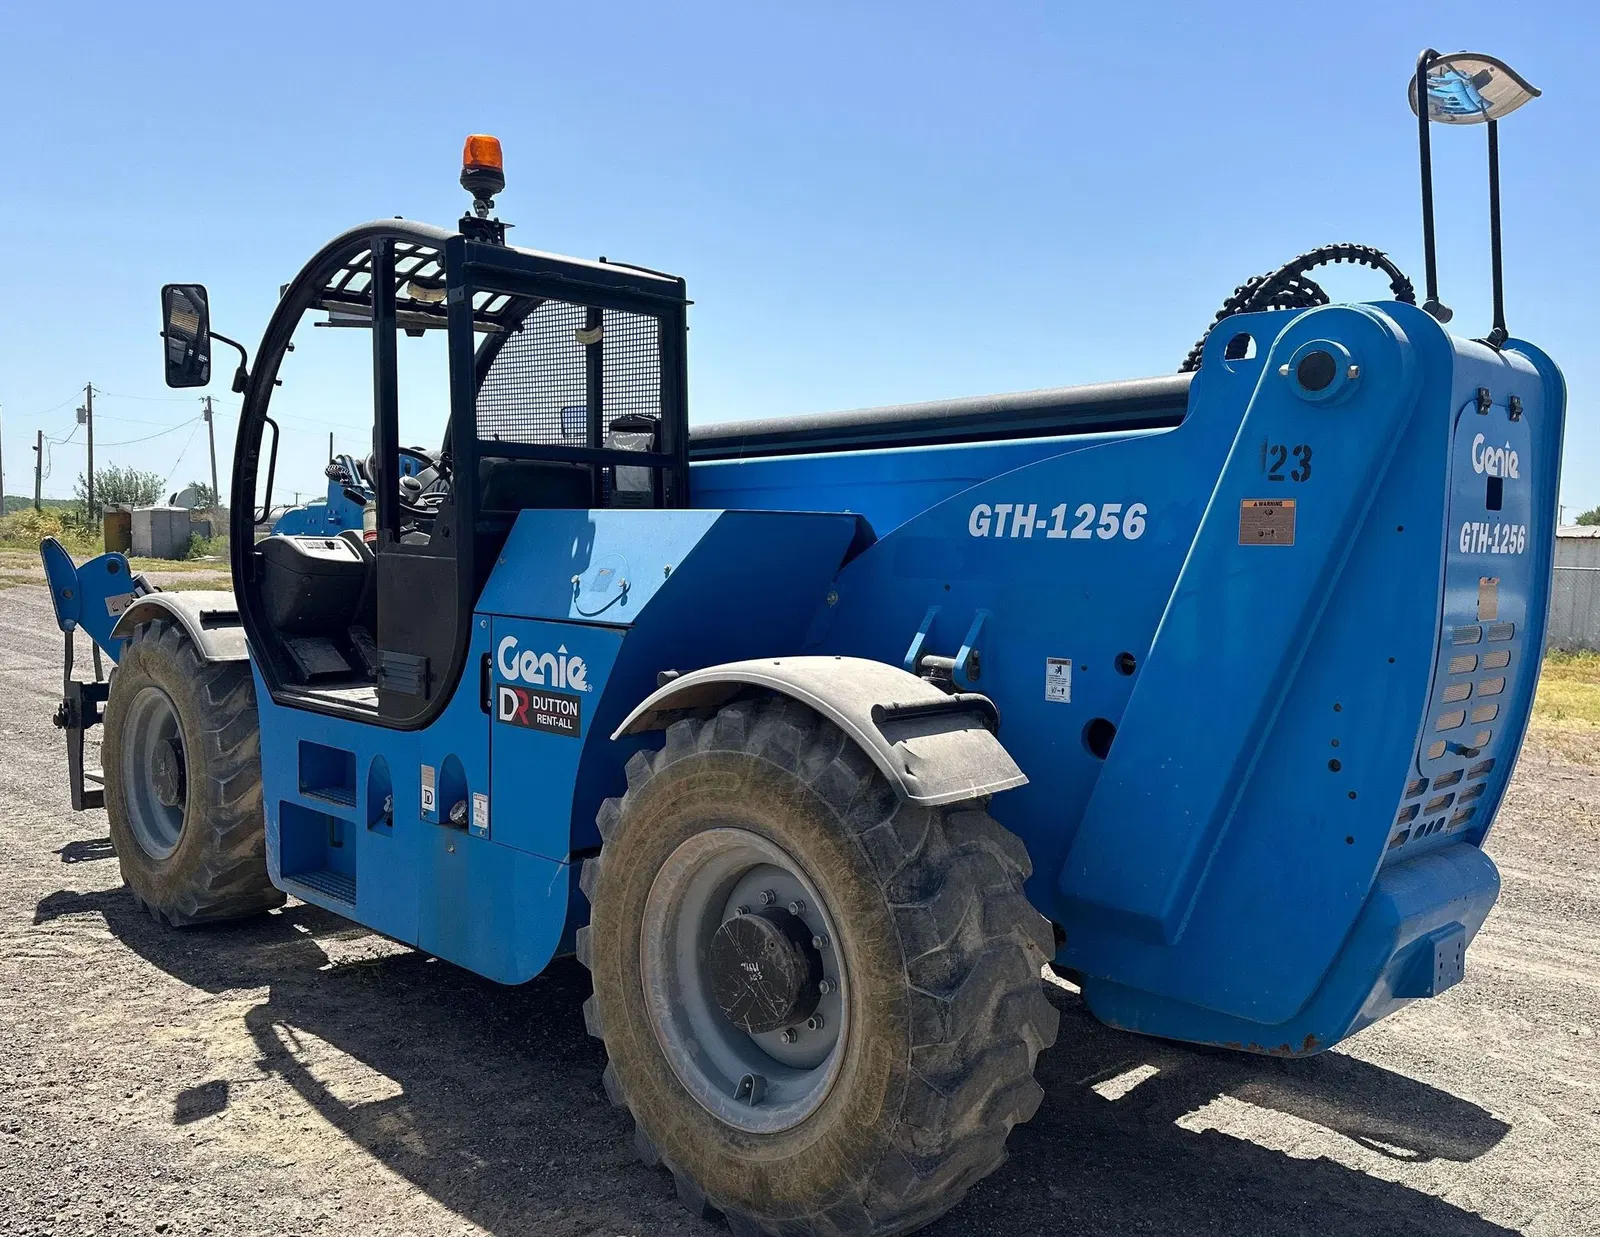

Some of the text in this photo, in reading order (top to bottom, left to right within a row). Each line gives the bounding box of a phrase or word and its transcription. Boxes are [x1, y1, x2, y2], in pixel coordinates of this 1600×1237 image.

[1471, 432, 1519, 479] Genie
[968, 503, 1148, 540] GTH-1256
[1459, 521, 1525, 555] GTH-1256
[497, 635, 588, 692] Genie
[499, 686, 529, 725] DR
[532, 695, 578, 717] DUTTON
[536, 713, 573, 730] RENT-ALL
